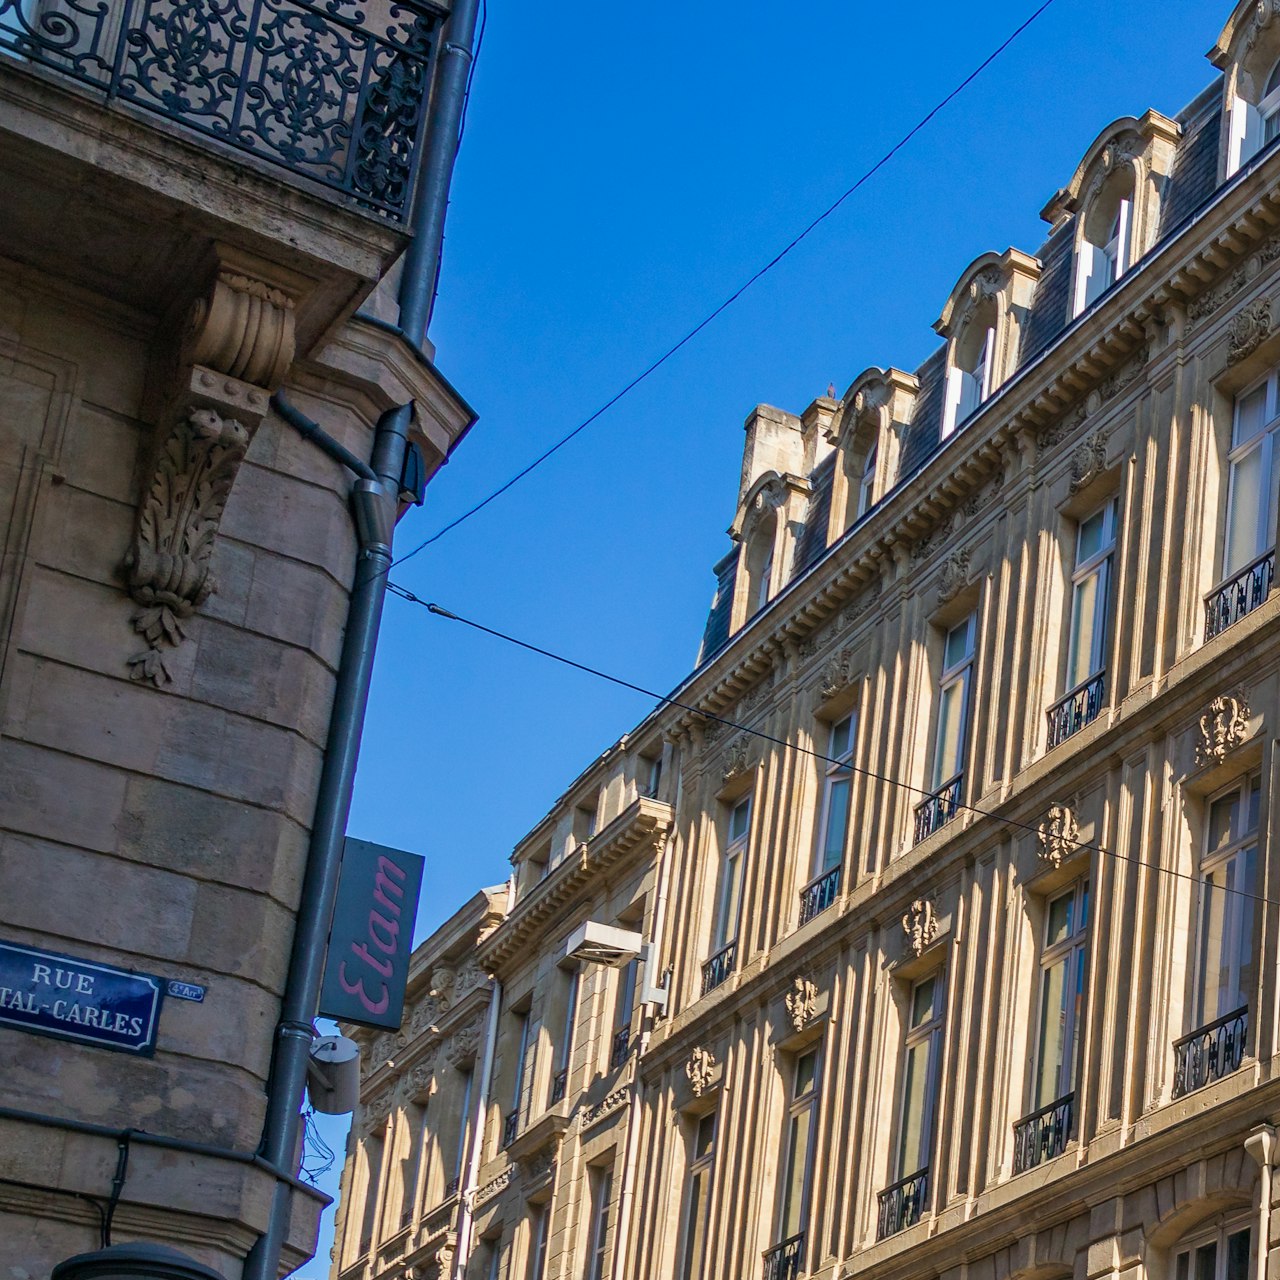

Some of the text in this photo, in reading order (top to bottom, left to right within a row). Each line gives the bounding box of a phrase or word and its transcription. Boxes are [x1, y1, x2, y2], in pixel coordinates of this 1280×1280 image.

[338, 855, 407, 1015] Etam
[32, 963, 95, 995] RUE
[0, 987, 143, 1037] TAL-CARLES
